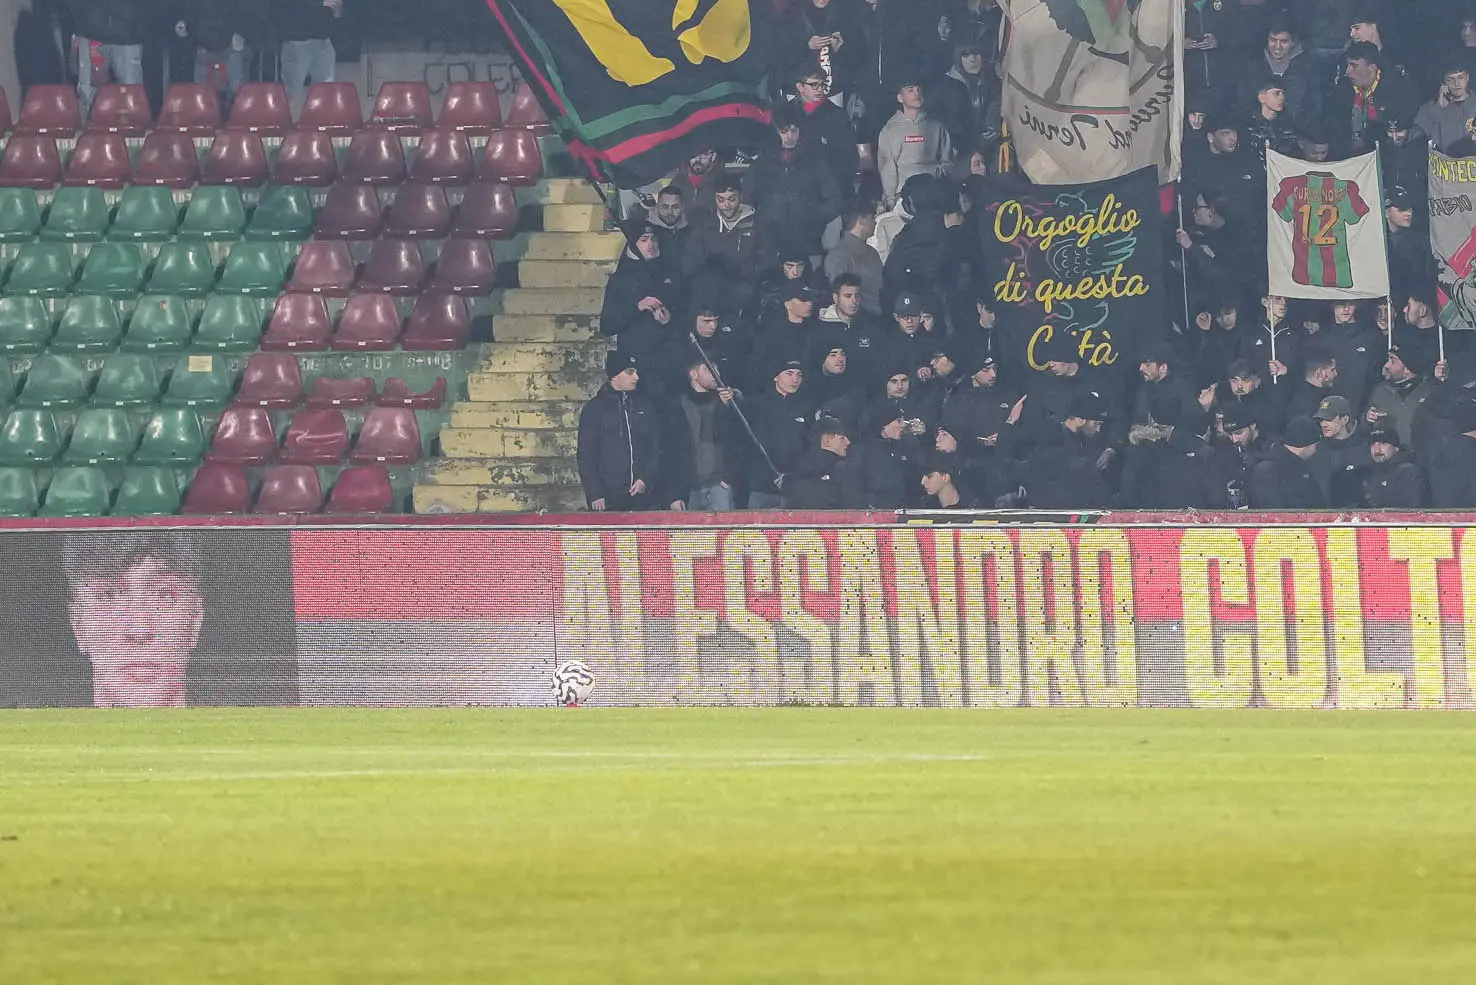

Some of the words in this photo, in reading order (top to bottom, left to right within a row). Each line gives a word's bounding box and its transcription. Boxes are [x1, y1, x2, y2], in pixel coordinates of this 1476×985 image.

[993, 193, 1141, 251] Orgoglio
[1299, 203, 1340, 246] 12
[993, 261, 1028, 303] di
[1035, 262, 1150, 313] questa
[1027, 324, 1119, 371] Ctà
